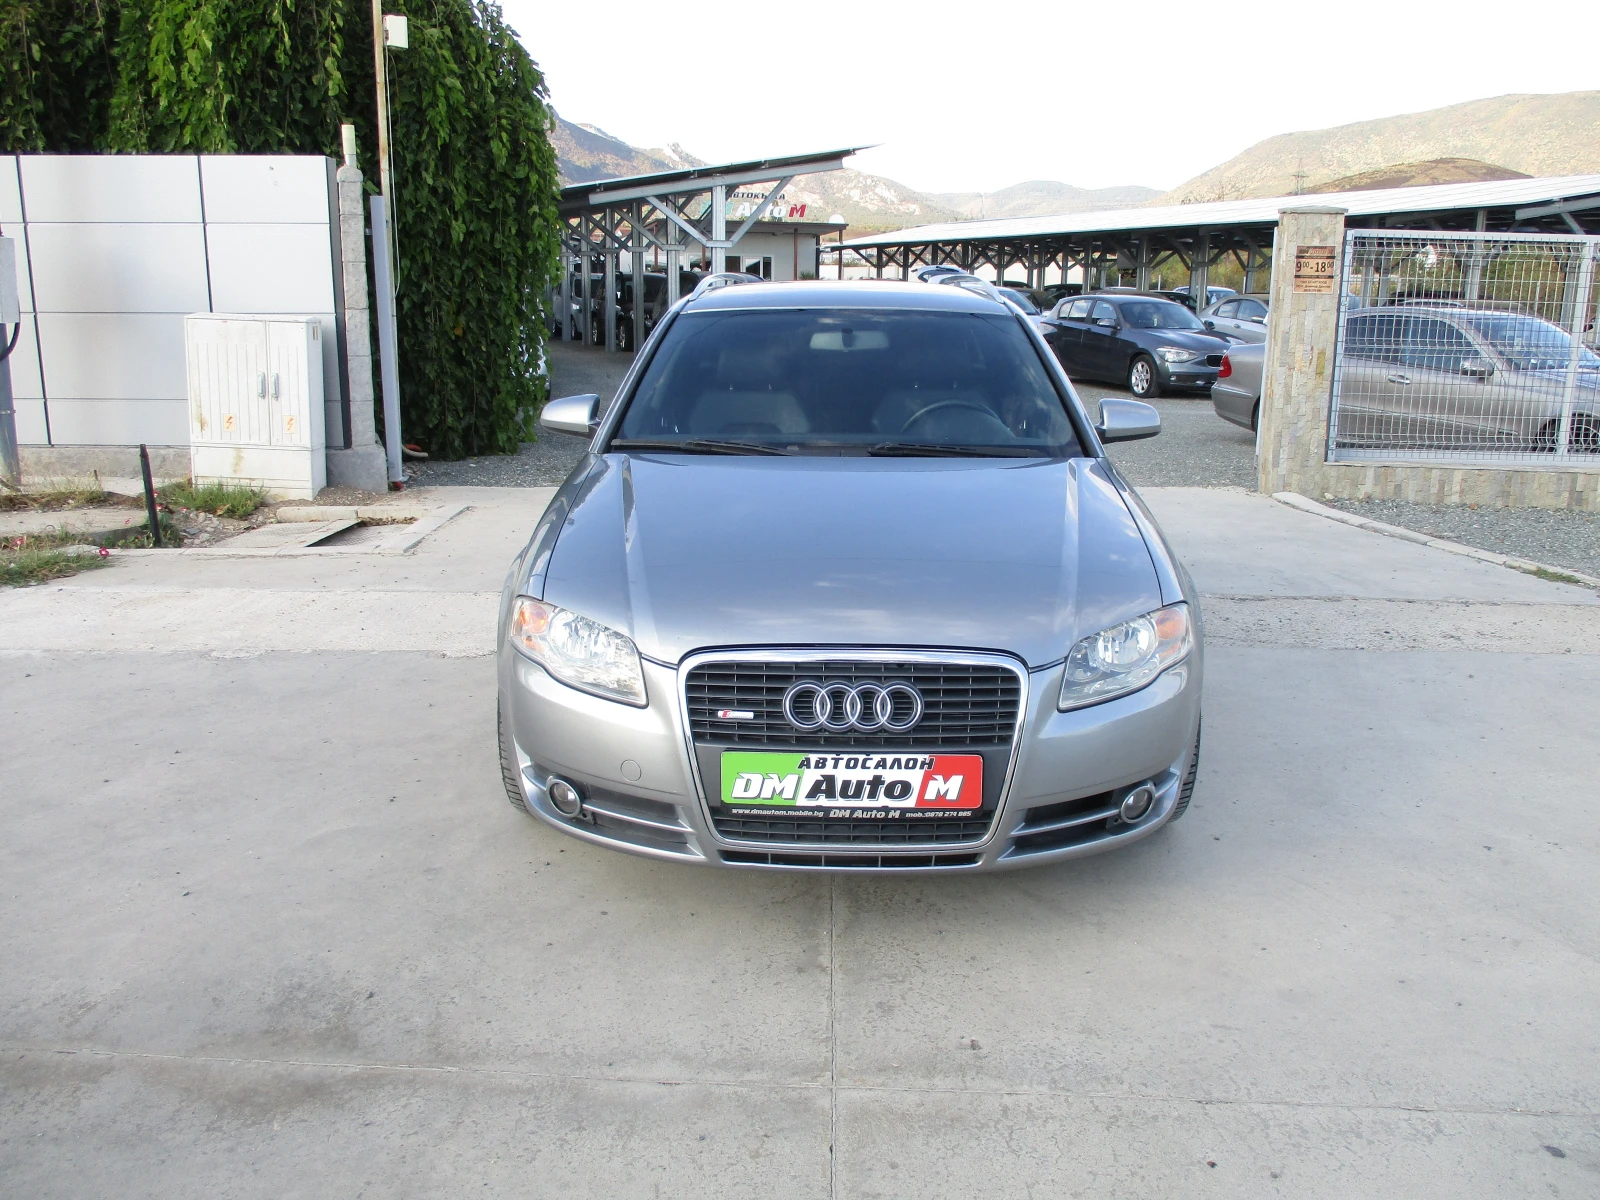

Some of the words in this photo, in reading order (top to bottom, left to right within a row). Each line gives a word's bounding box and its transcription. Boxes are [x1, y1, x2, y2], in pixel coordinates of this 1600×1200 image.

[788, 204, 807, 218] M
[797, 757, 935, 770] АВТОСАЛОН
[731, 772, 800, 800] DM
[804, 774, 915, 801] Auto
[923, 774, 965, 802] M
[731, 808, 824, 818] www.dmautom.mobile.bg
[829, 809, 851, 818] DM
[852, 809, 886, 819] Auto
[887, 810, 901, 819] M
